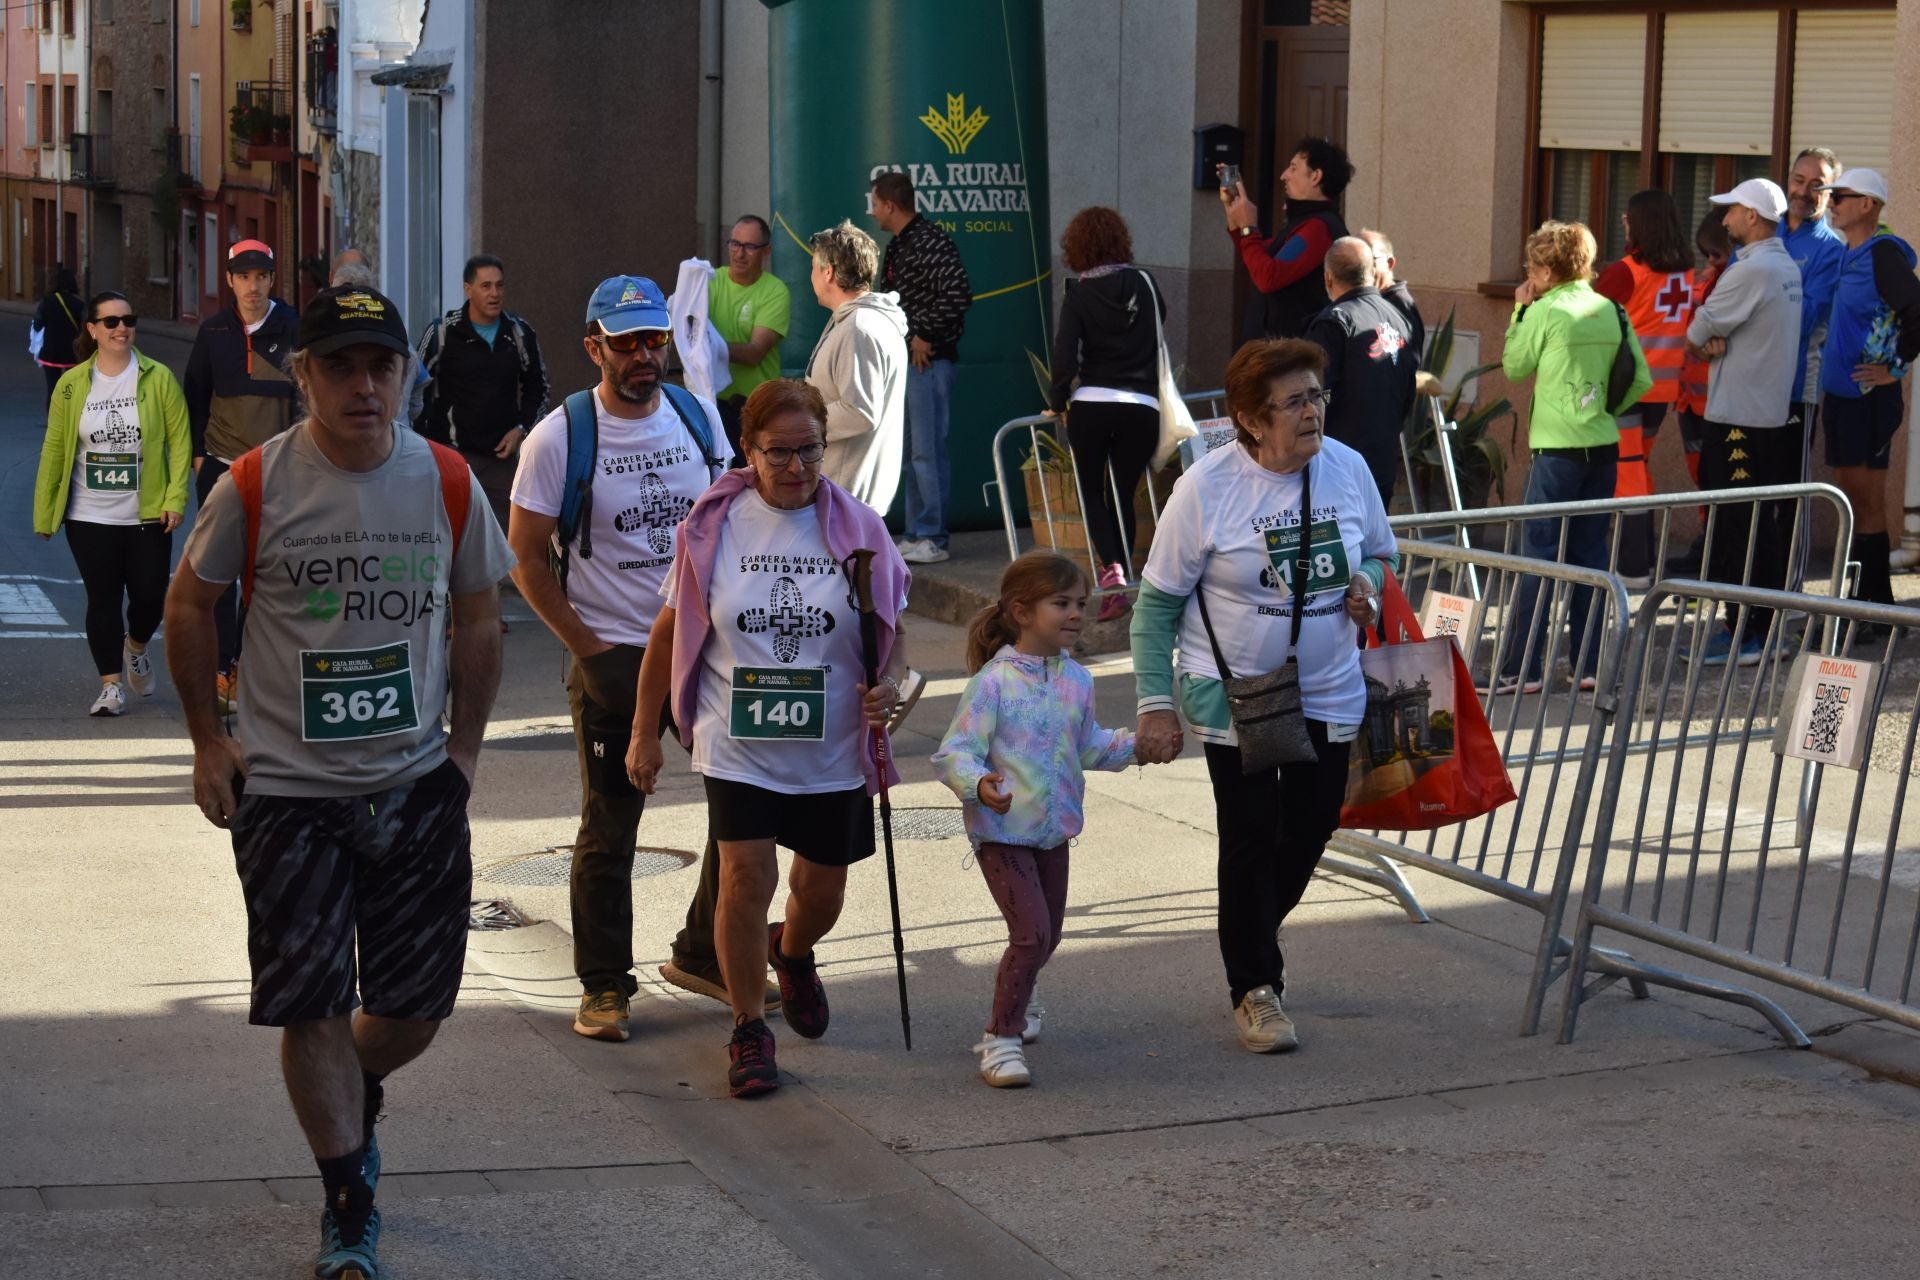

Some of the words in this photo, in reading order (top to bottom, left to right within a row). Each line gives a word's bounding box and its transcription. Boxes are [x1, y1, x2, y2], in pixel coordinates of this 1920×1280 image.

[946, 163, 1025, 186] RURAL
[914, 190, 1030, 213] NAVARRA
[965, 220, 1013, 233] SOCIAL
[340, 312, 384, 321] GUATEMALA
[87, 402, 134, 411] SOLIDARI
[605, 454, 690, 475] SOLIDARIA
[94, 469, 130, 485] 144
[283, 532, 328, 548] Cuando
[331, 532, 342, 544] la
[345, 531, 370, 543] ELA
[372, 533, 386, 543] no
[388, 532, 399, 543] te
[402, 531, 412, 543] la
[414, 532, 442, 545] pELA
[740, 563, 837, 575] SOLIDARIA
[1276, 553, 1336, 584] 18
[343, 590, 435, 627] RIOJA
[321, 686, 400, 724] 362
[747, 699, 810, 727] 140
